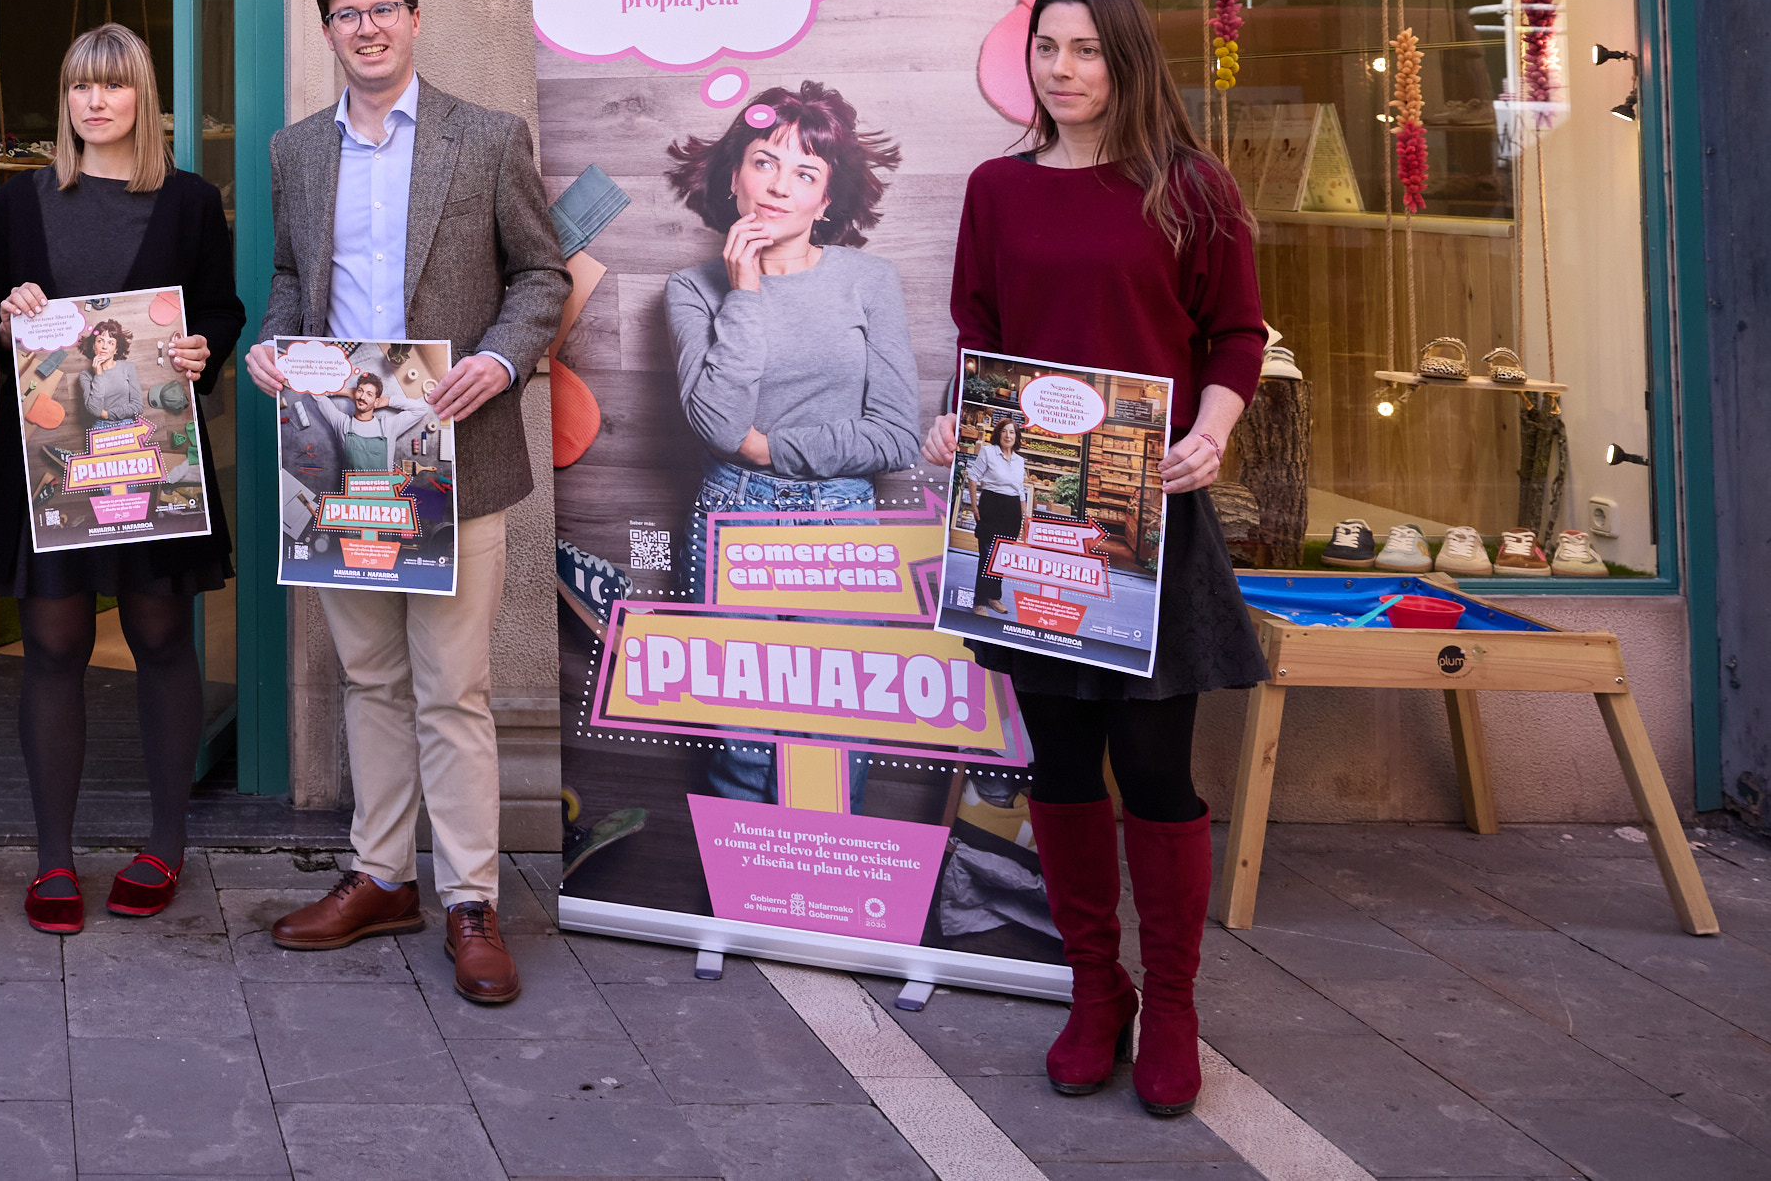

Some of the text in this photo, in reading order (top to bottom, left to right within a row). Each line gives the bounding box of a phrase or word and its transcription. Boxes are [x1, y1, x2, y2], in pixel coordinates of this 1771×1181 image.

[72, 456, 154, 482] ¡PLANAZO!
[325, 503, 407, 524] ¡PLANAZO!
[726, 542, 896, 563] comercios
[729, 567, 898, 586] en marcha
[1000, 552, 1097, 585] PLAN PUSKA!
[1002, 624, 1083, 647] NAVARRA NAFARROA
[1439, 655, 1464, 668] plum
[625, 634, 970, 722] ¡PLANAZO!
[733, 822, 900, 852] Monta tu propio comercio
[714, 837, 921, 869] o toma el relevo de uno existente
[741, 853, 892, 882] y diseña tu plan de vida
[744, 901, 788, 914] de Navarra
[750, 893, 787, 905] Gobierno
[808, 901, 854, 914] Nafarroako
[808, 910, 849, 922] Gobernua
